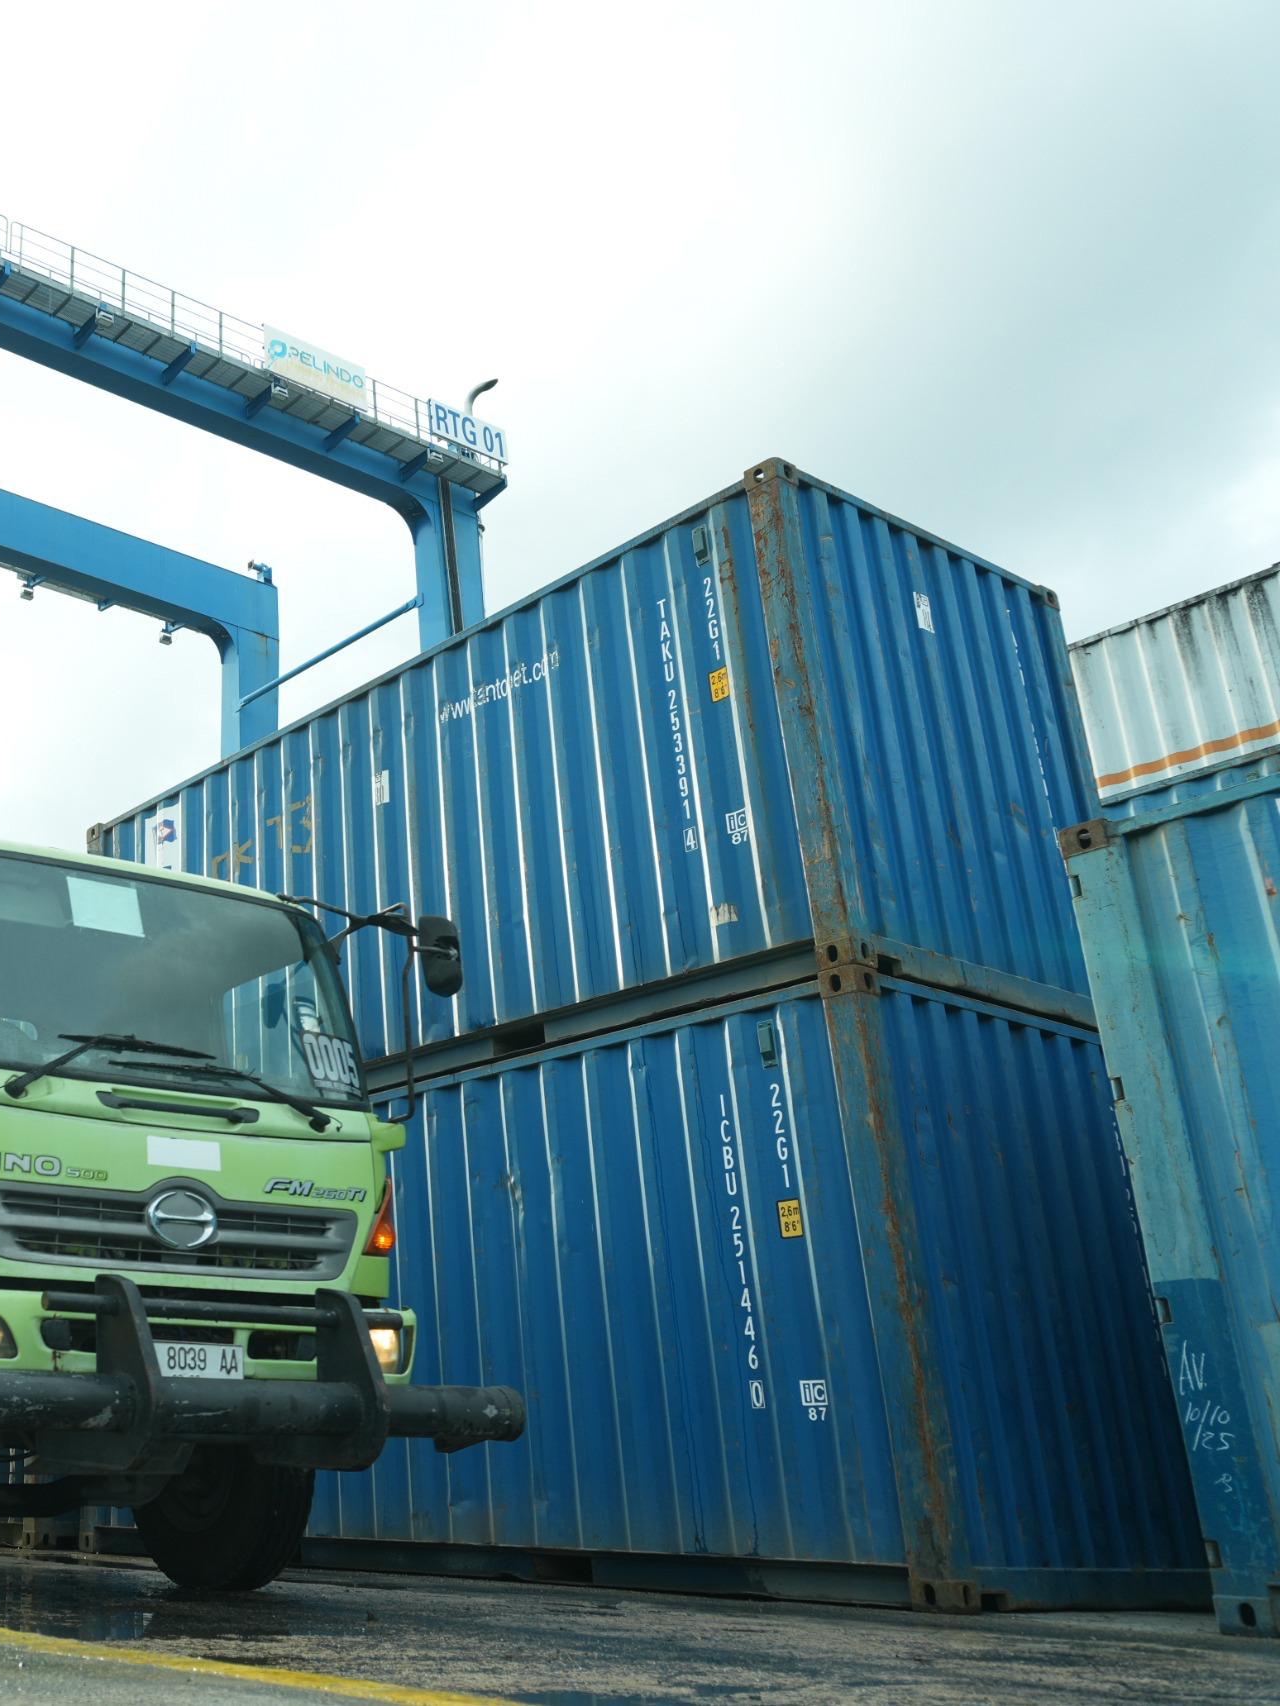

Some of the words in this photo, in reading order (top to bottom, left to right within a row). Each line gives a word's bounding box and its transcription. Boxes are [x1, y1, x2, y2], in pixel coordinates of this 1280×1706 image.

[287, 346, 364, 389] PELINDO
[435, 404, 477, 446] RTG
[483, 431, 505, 458] 01
[703, 577, 720, 660] 22G1
[656, 598, 675, 682] TAKU
[669, 689, 690, 819] 253391
[769, 1082, 790, 1188] 22G1
[66, 1167, 108, 1181] 500
[720, 1094, 736, 1196] ICBU
[730, 1206, 759, 1370] 251446
[167, 1346, 207, 1371] 8039
[219, 1348, 238, 1375] AA
[808, 1407, 827, 1421] 87
